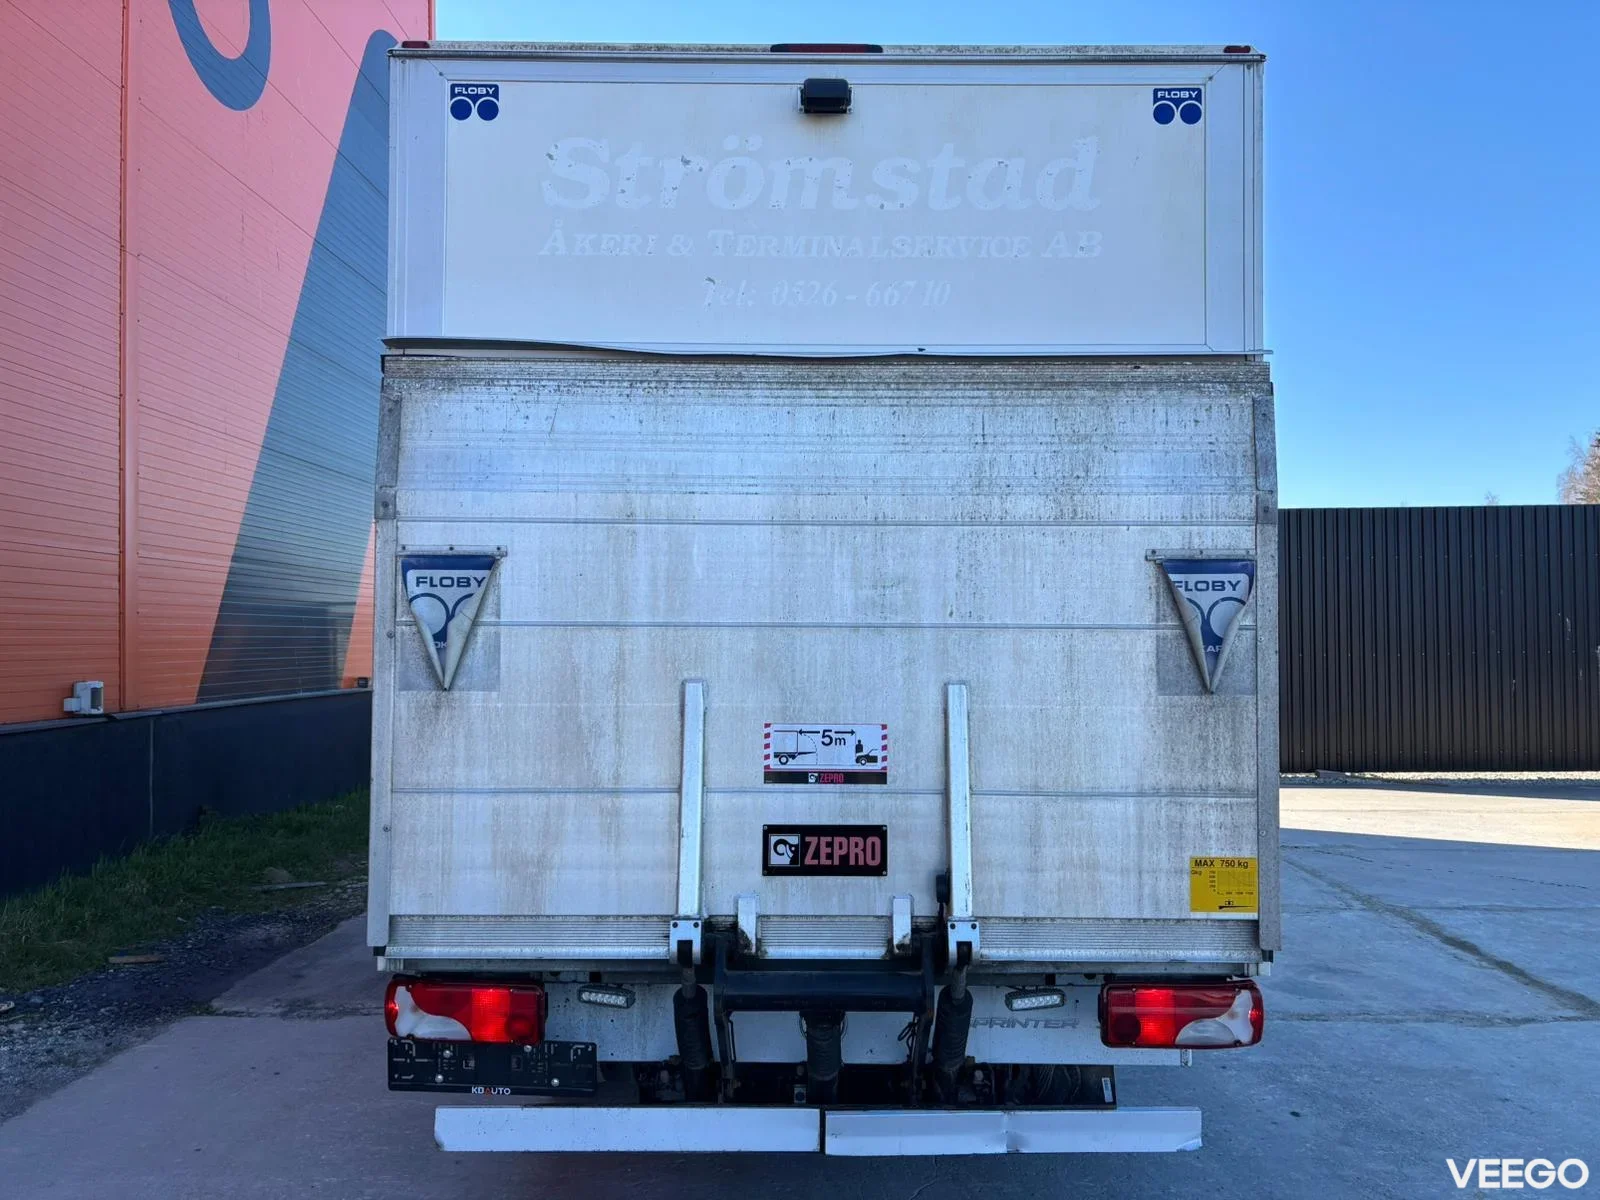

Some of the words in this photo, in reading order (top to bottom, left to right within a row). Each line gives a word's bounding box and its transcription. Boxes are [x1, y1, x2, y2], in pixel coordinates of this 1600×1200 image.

[454, 86, 496, 95] FLOBY
[1157, 90, 1199, 99] FLOBY
[540, 134, 1102, 211] Strömstad
[537, 219, 659, 257] ÅKERI
[666, 233, 696, 257] &
[707, 229, 1033, 258] TERMINALSERVICE
[1040, 230, 1104, 258] AB
[415, 576, 486, 588] FLOBY
[819, 773, 845, 784] ZEPRO
[804, 836, 882, 866] ZEPRO
[1194, 859, 1215, 867] MAX
[1220, 859, 1236, 868] 750
[1237, 859, 1249, 870] kg
[970, 1016, 1080, 1029] PRINTER
